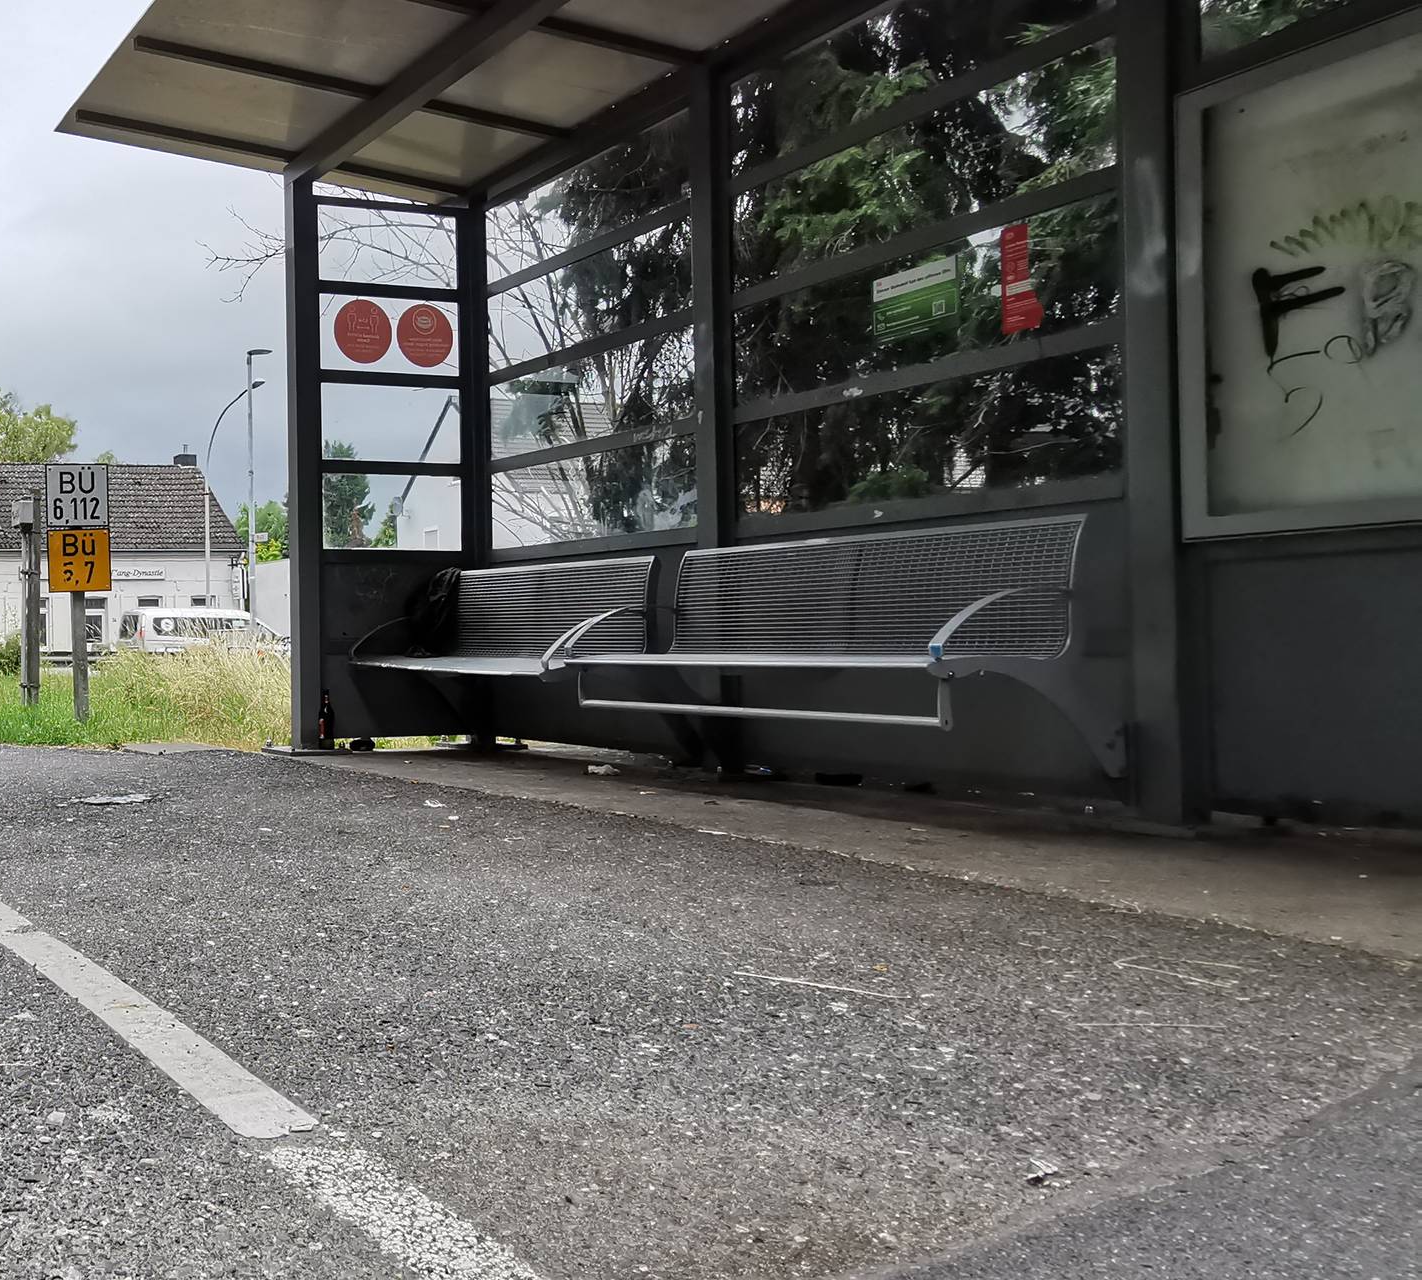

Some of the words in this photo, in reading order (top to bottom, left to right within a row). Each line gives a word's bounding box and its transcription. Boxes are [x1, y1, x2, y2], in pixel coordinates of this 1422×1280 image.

[59, 466, 95, 494] BÜ
[53, 497, 100, 524] 6,112
[62, 533, 96, 557] Bü
